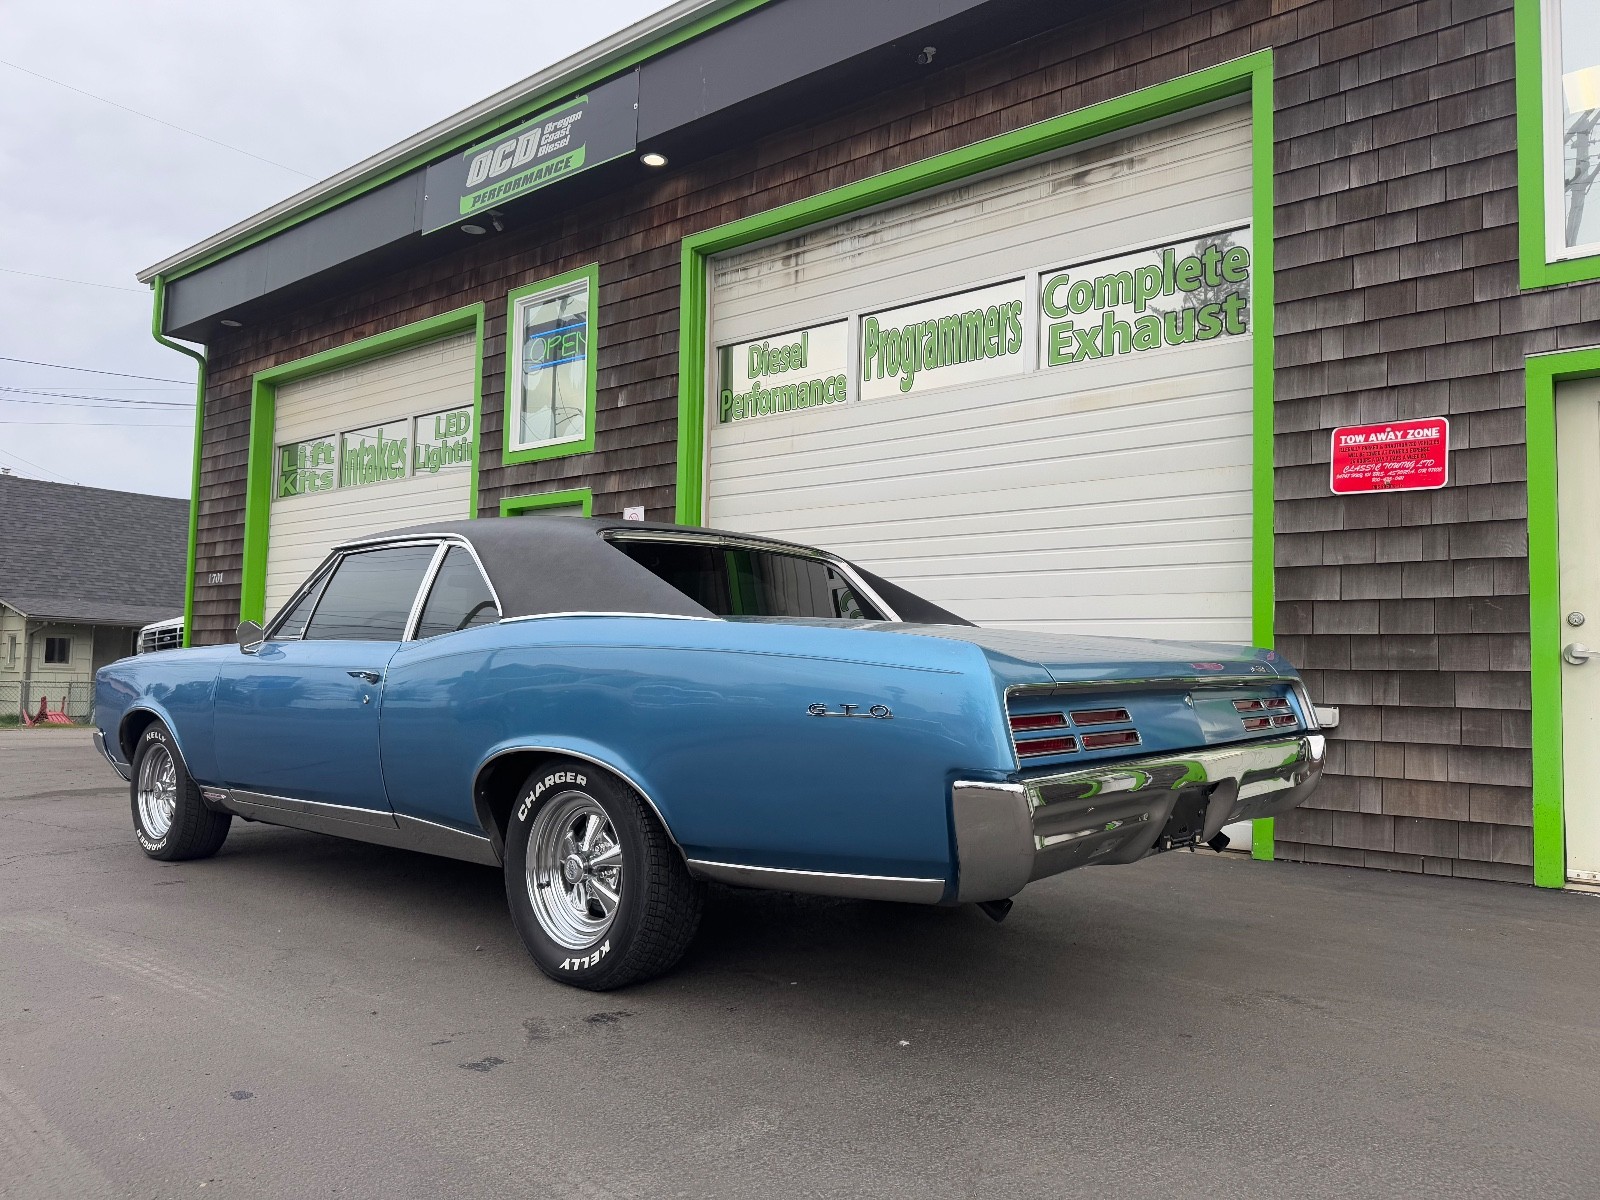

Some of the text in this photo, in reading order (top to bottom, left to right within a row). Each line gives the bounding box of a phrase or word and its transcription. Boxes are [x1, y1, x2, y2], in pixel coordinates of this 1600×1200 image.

[540, 124, 572, 145] Coast
[543, 110, 583, 133] Oregon
[465, 126, 542, 188] OCD
[537, 137, 570, 158] Diesel
[470, 153, 575, 208] PERFORMANCE
[1042, 244, 1250, 319] Complete
[1048, 292, 1247, 367] Exhaust
[748, 331, 809, 379] Diesel
[863, 299, 1022, 392] Programmers
[720, 373, 847, 423] Performance
[434, 411, 471, 440] LED
[1340, 427, 1440, 445] TOW AWAY ZONE
[282, 441, 334, 472] Lift
[342, 428, 408, 488] Intakes
[1343, 463, 1382, 474] CLASSIC
[279, 470, 334, 498] Kits
[146, 731, 166, 743] KELLY
[517, 771, 588, 822] CHARGER
[136, 829, 167, 851] CHARGER
[559, 939, 611, 971] KELLY
